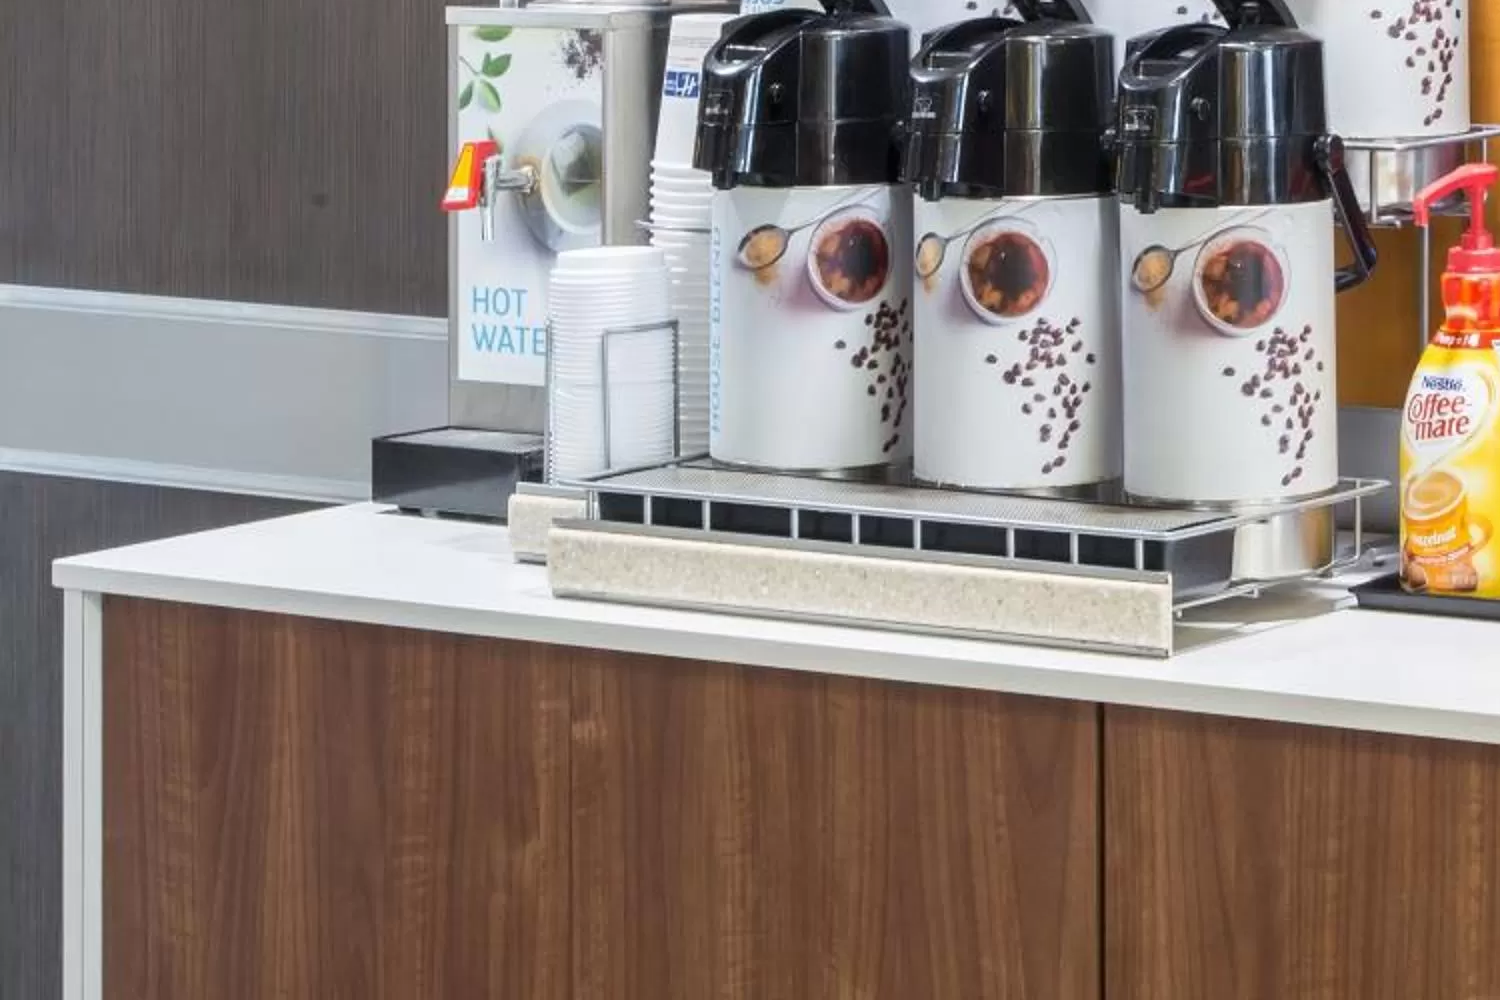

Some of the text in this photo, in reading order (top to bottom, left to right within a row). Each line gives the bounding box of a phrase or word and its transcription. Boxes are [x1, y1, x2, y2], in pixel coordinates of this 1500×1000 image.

[472, 285, 528, 317] HOT
[471, 322, 546, 356] WATE
[1415, 415, 1470, 440] mate
